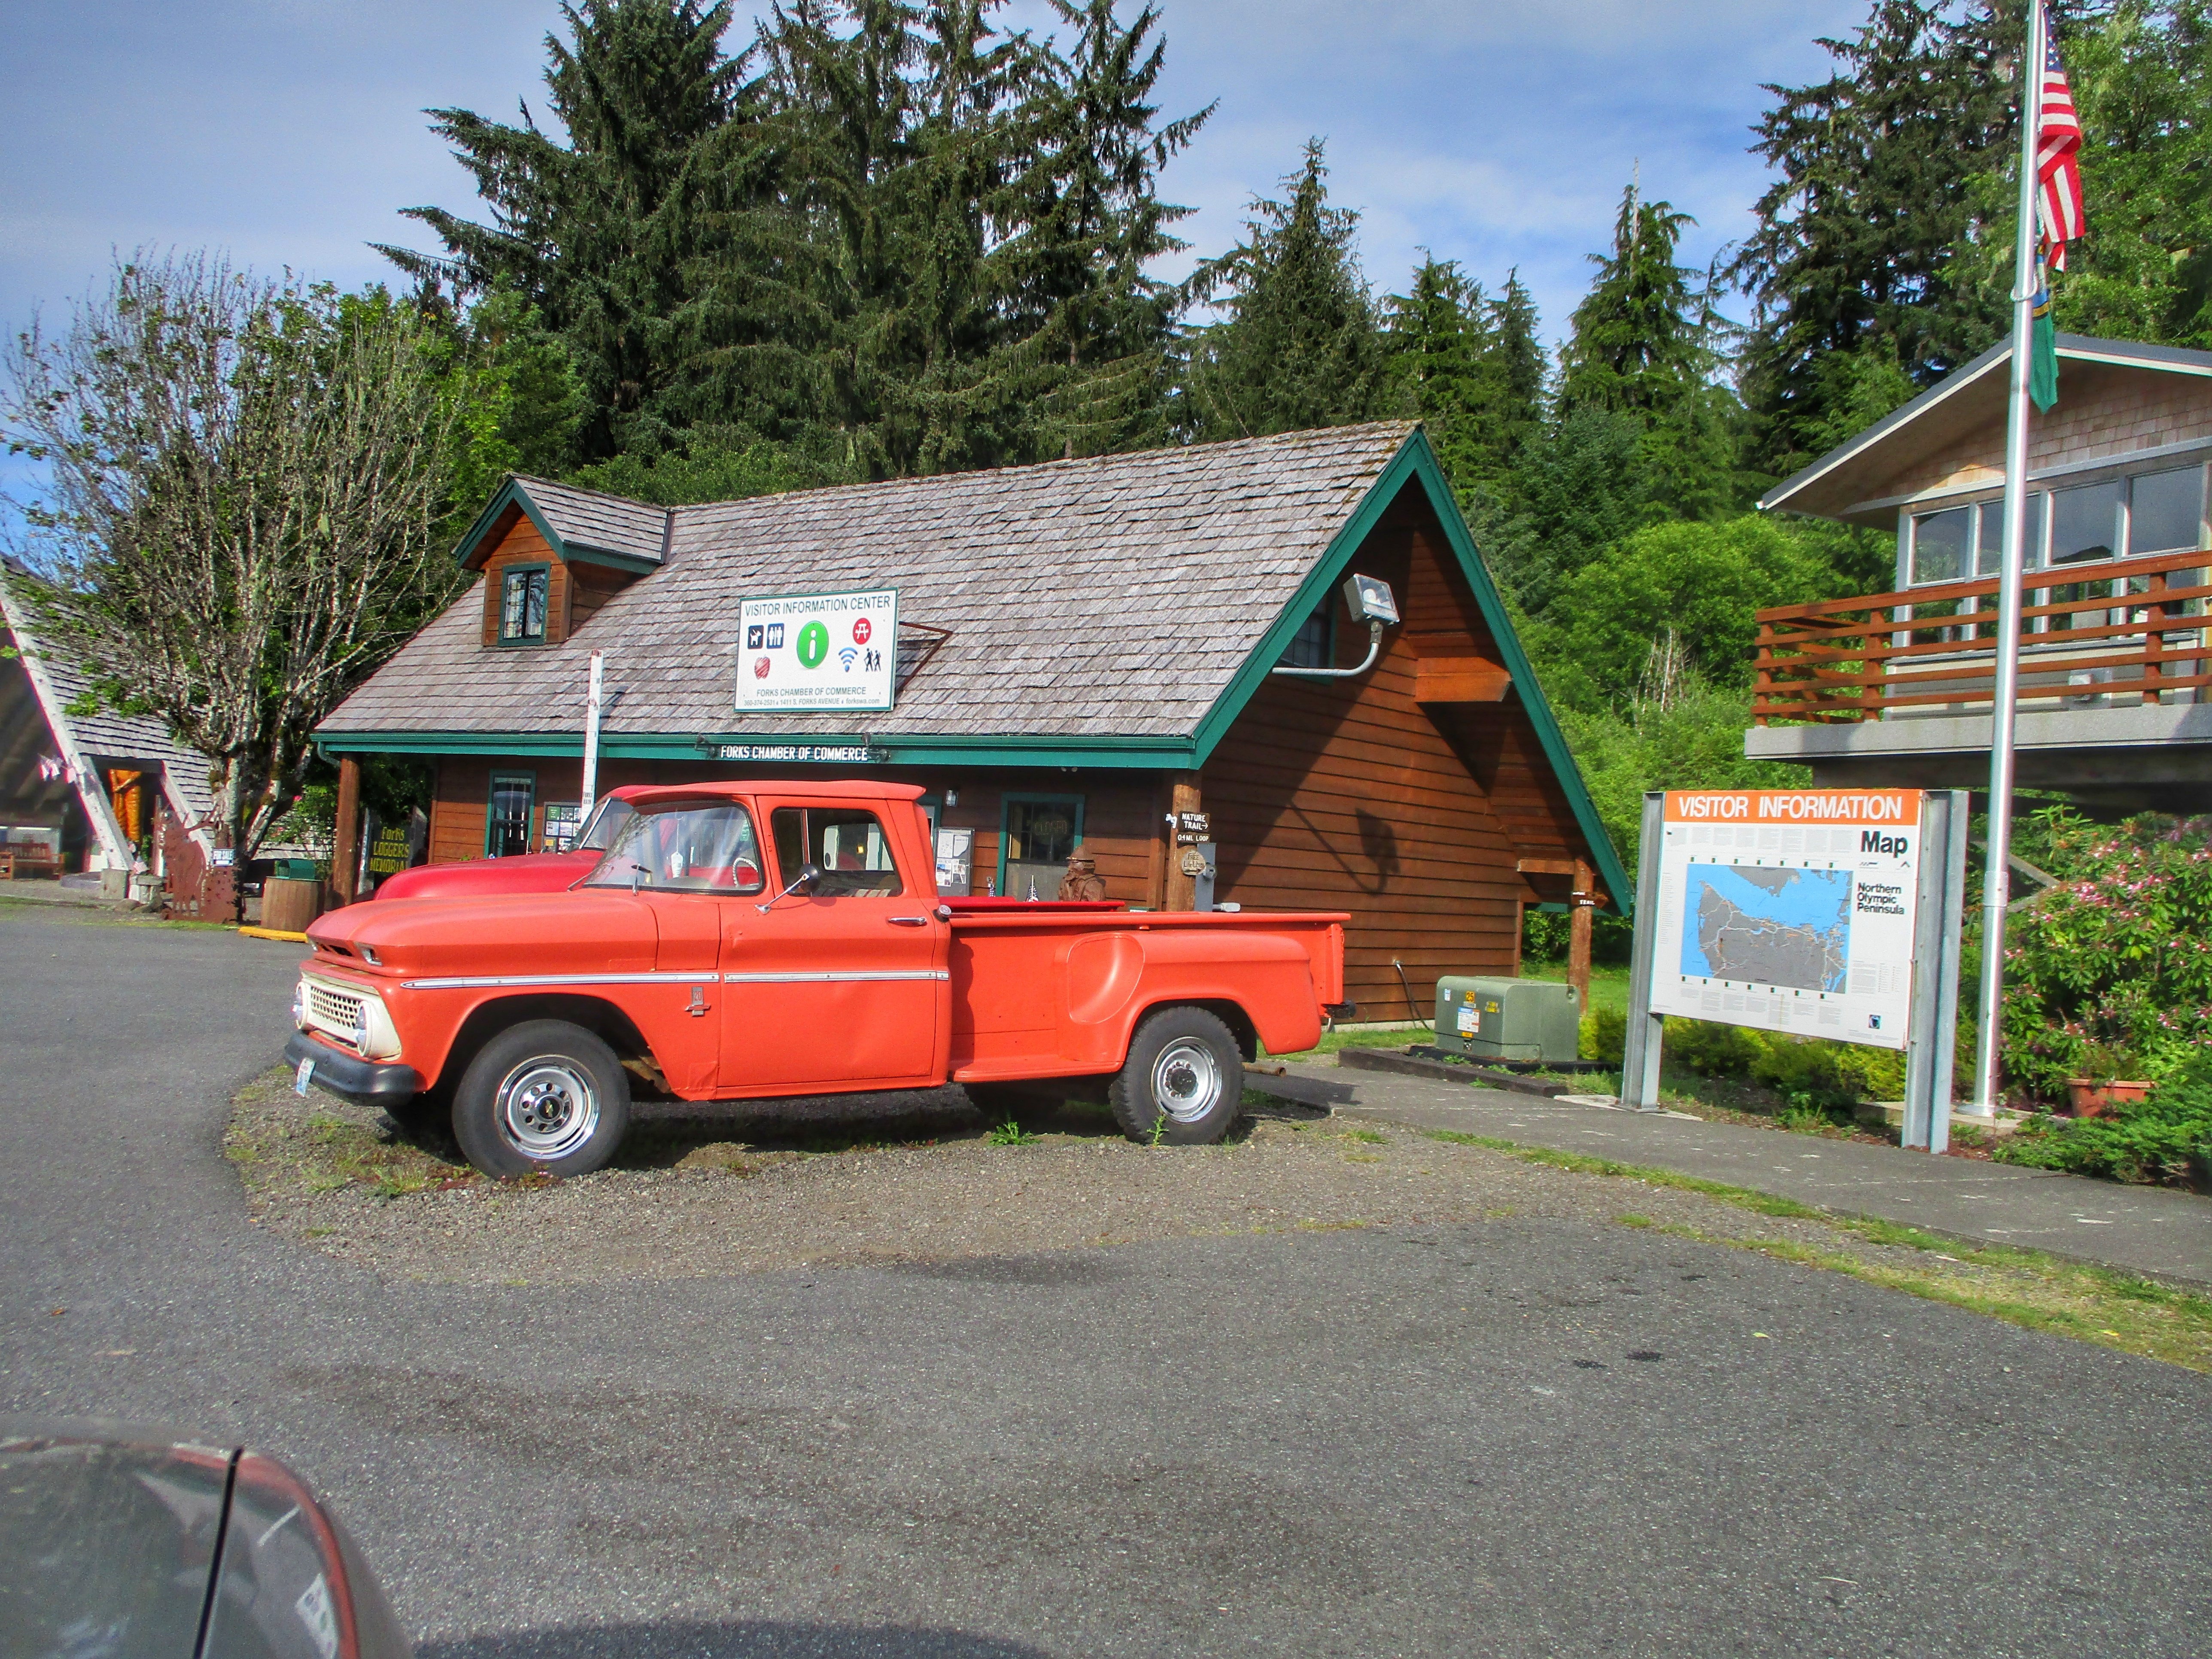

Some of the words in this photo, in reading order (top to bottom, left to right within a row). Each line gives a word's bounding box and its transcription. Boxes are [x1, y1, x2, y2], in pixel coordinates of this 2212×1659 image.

[745, 603, 780, 617] VISITOR
[783, 598, 848, 614] INFORMATION
[851, 596, 890, 610] CENTER
[757, 689, 779, 697] FORKS
[780, 688, 813, 696] CHAMBER
[826, 687, 866, 695] COMMERCE
[721, 745, 750, 759] FORKS
[752, 746, 796, 760] CHAMBER
[798, 747, 811, 760] OF
[814, 747, 868, 761] COMMERCE
[1679, 796, 1749, 818] VISITOR
[1759, 795, 1902, 820] INFORMATION
[1182, 813, 1206, 822] NATURE
[1184, 820, 1202, 830] TRAIL
[1861, 831, 1908, 858] Map
[1857, 882, 1902, 894] Northern
[1856, 892, 1897, 905] Olympic
[1856, 902, 1905, 915] Peninsula
[1466, 992, 1474, 1002] 25
